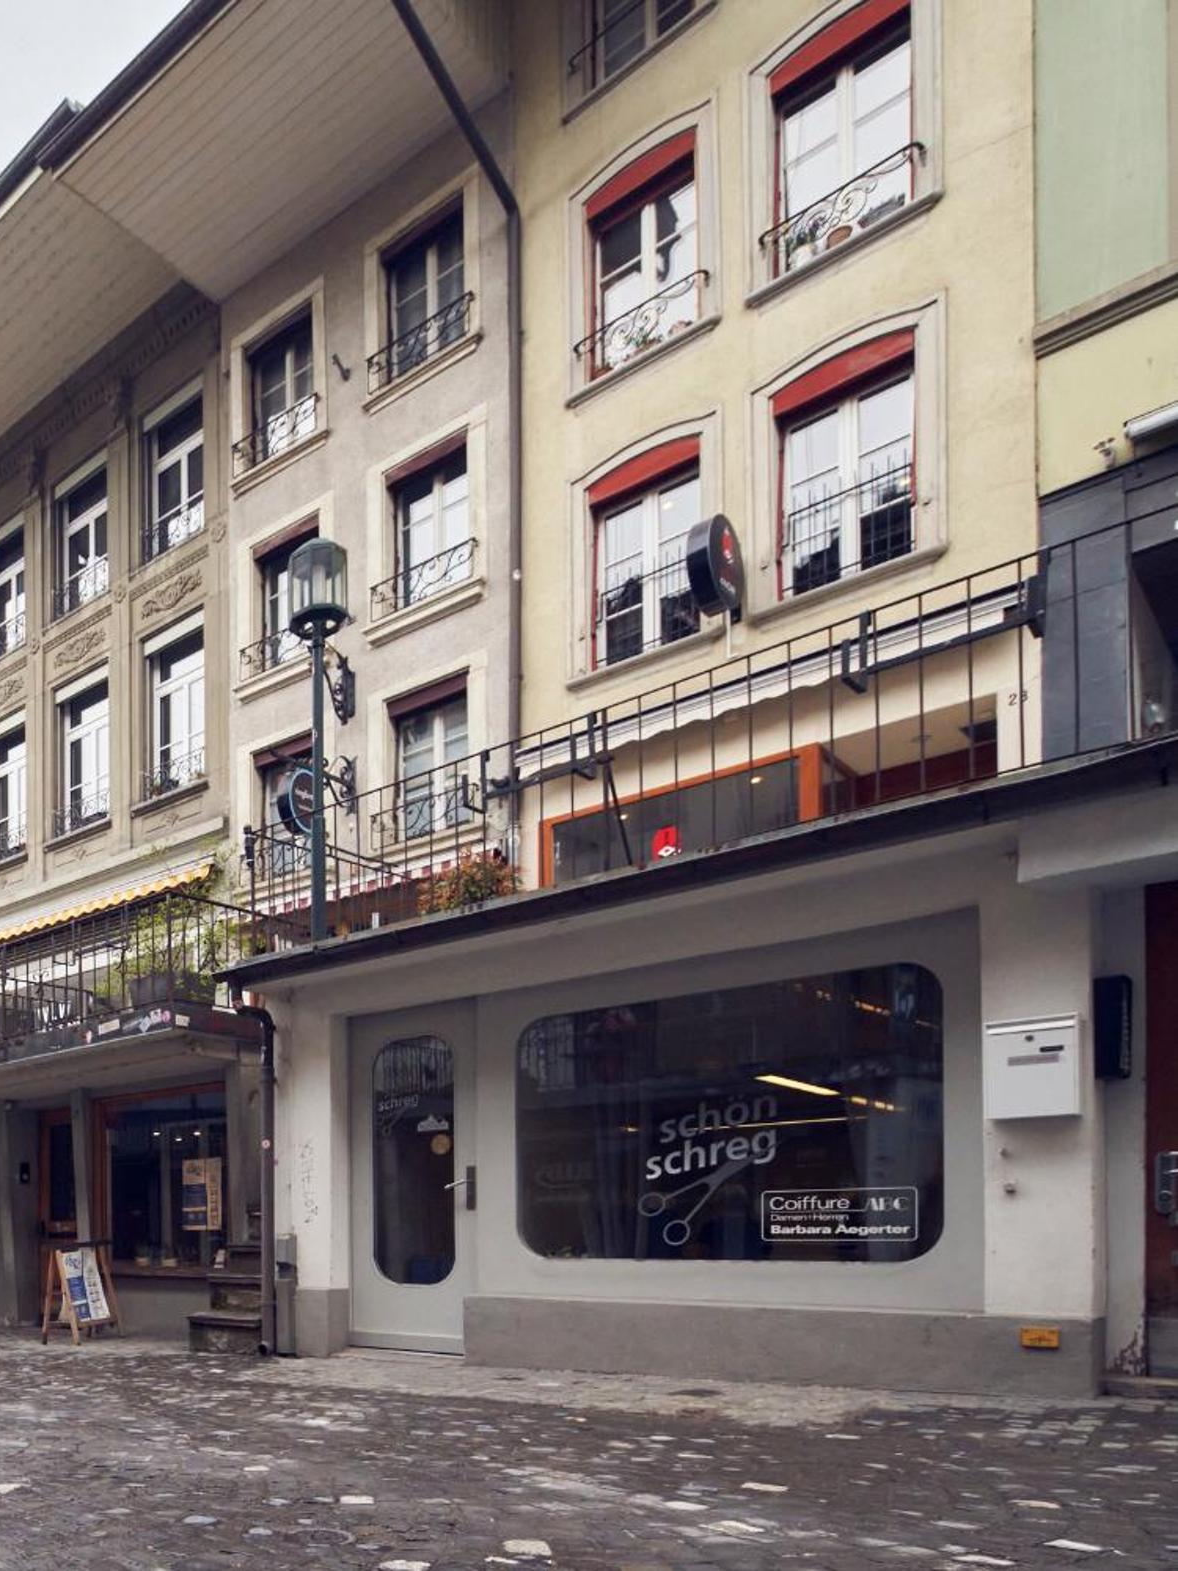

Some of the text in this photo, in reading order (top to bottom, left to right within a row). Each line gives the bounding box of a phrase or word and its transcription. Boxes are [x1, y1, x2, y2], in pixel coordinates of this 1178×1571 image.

[659, 1094, 777, 1144] schön
[645, 1128, 777, 1180] schreg
[769, 1196, 850, 1211] Coiffure
[770, 1223, 911, 1237] Barbara Aegerter
